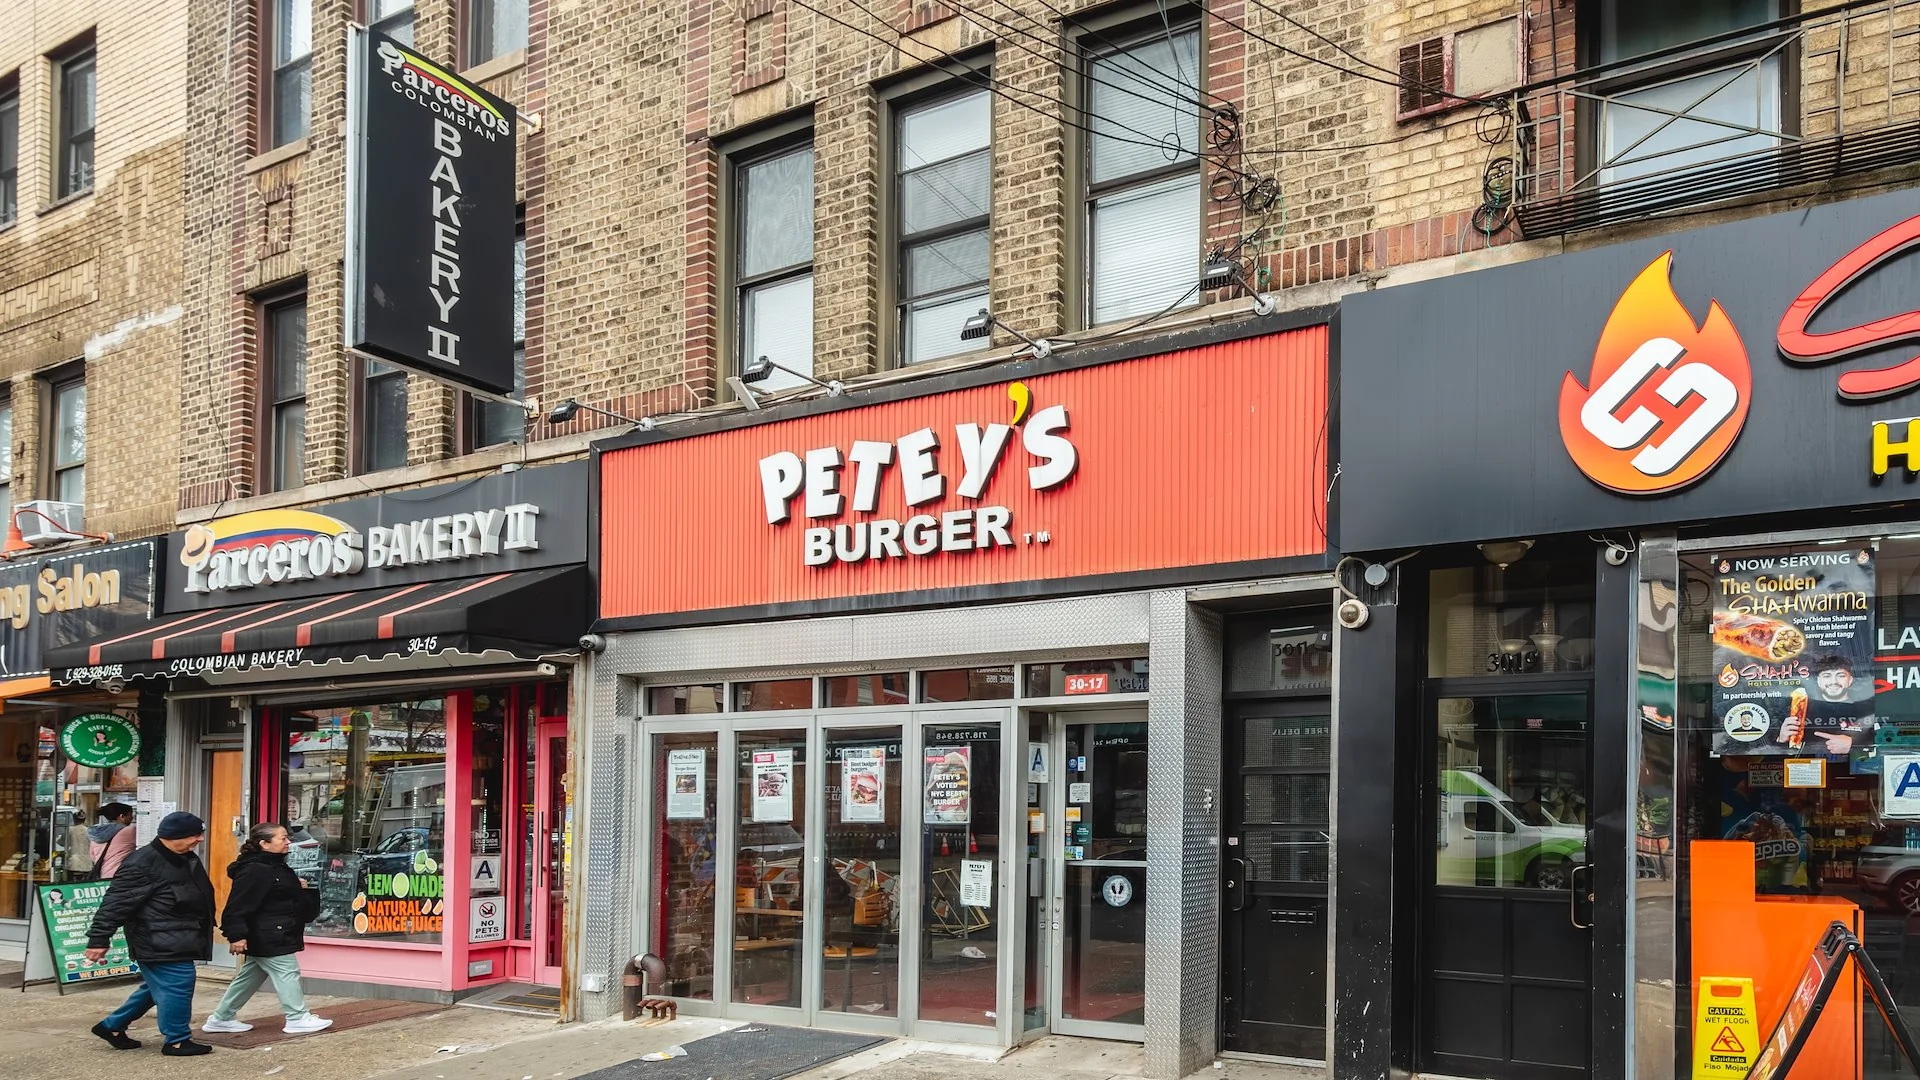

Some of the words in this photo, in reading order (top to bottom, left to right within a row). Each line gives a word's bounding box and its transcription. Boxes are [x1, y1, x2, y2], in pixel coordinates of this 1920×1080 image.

[381, 57, 510, 137] Parceros
[391, 81, 496, 142] COLOMBIAN
[428, 118, 463, 324] BAKERY
[759, 382, 1079, 525] PETEY'S
[804, 505, 1016, 566] BURGER
[184, 532, 364, 594] Parceros
[368, 508, 506, 569] BAKERY
[1735, 559, 1774, 571] NOW
[1780, 553, 1850, 569] SERVING
[36, 563, 120, 614] Salon
[1720, 577, 1751, 595] The
[1755, 573, 1815, 594] Golden
[1793, 617, 1808, 625] Spicy
[1809, 615, 1831, 623] Chicken
[1832, 614, 1867, 622] Shahwarma
[407, 636, 437, 652] 30-15
[1837, 631, 1854, 639] tangy
[170, 653, 245, 672] COLOMBIAN
[251, 648, 303, 666] BAKERY
[1486, 650, 1540, 676] 3019
[73, 664, 122, 679] 929-328-0155
[1069, 677, 1104, 690] 30-17
[1730, 691, 1766, 700] partnership
[90, 713, 124, 724] ORGANIC
[475, 860, 493, 879] A
[367, 900, 422, 916] NATURAL
[410, 915, 443, 934] JUICE
[475, 926, 499, 934] PETS
[79, 971, 93, 979] WE
[93, 969, 108, 977] ARE
[110, 967, 130, 975] OPEN
